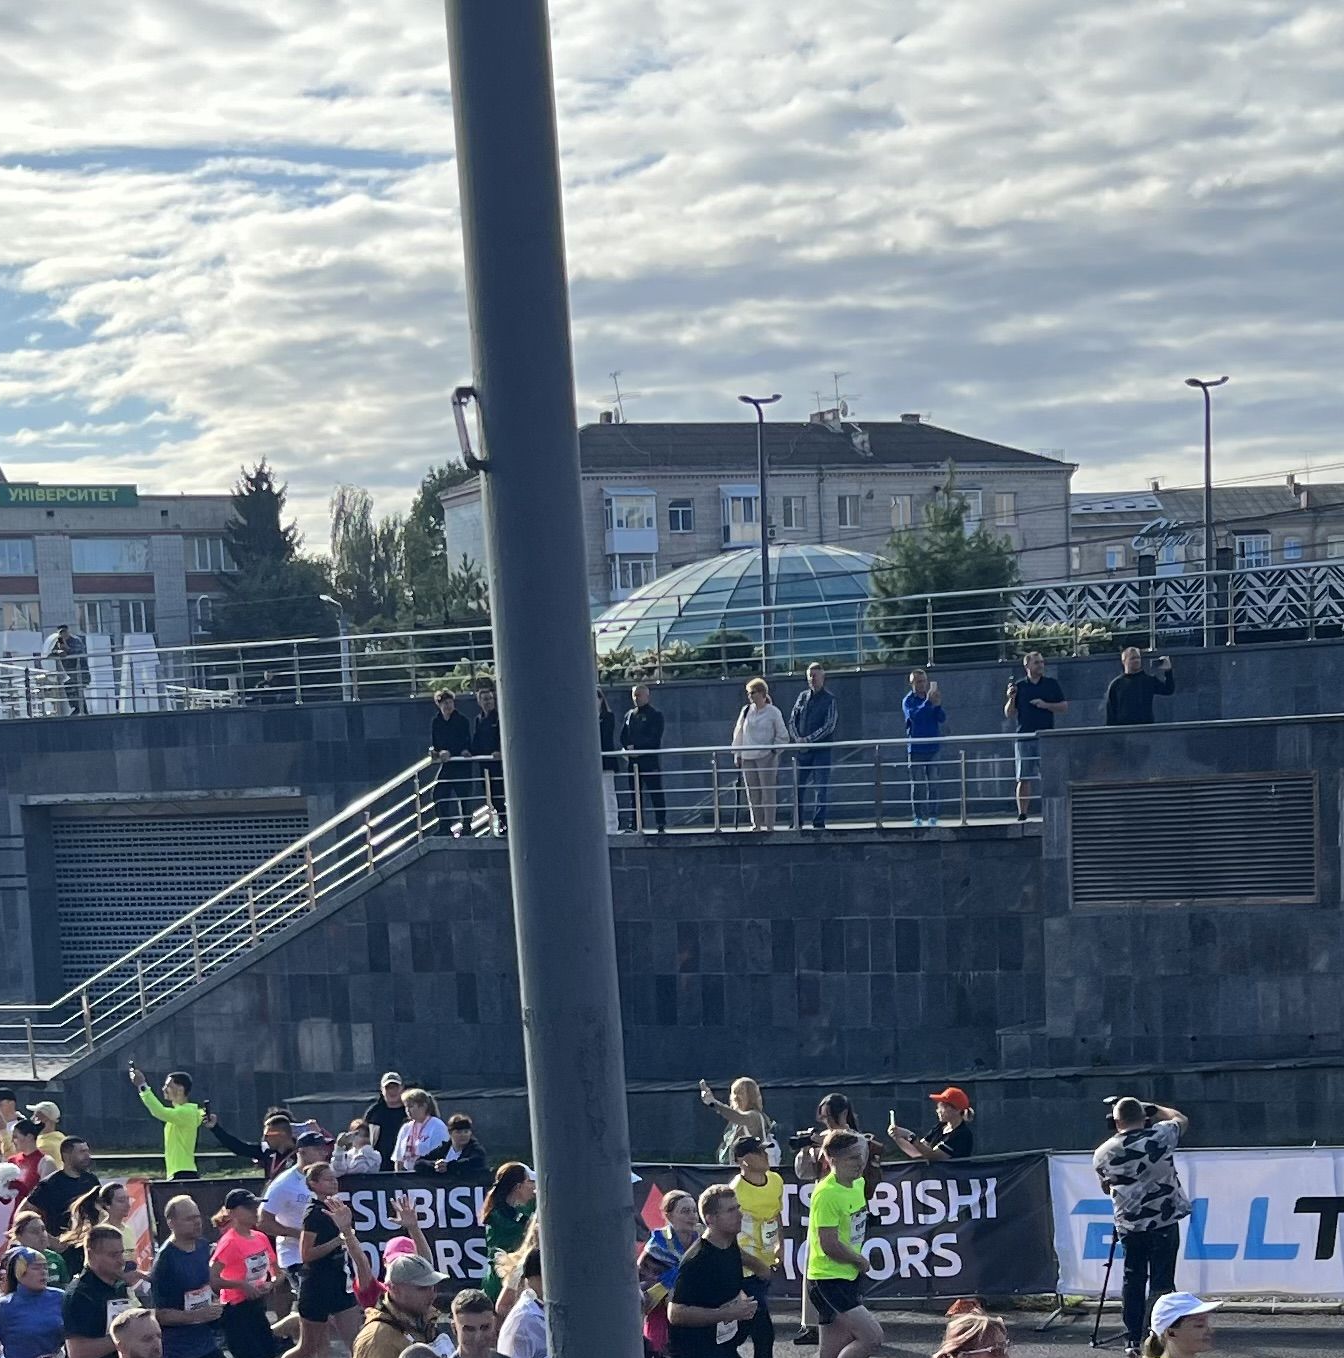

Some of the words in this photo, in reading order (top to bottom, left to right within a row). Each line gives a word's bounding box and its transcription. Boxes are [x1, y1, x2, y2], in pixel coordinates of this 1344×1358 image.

[8, 487, 119, 502] УНІВЕРСИТЕТ
[336, 1186, 485, 1232] SUBIS
[781, 1176, 999, 1228] TSBISHI
